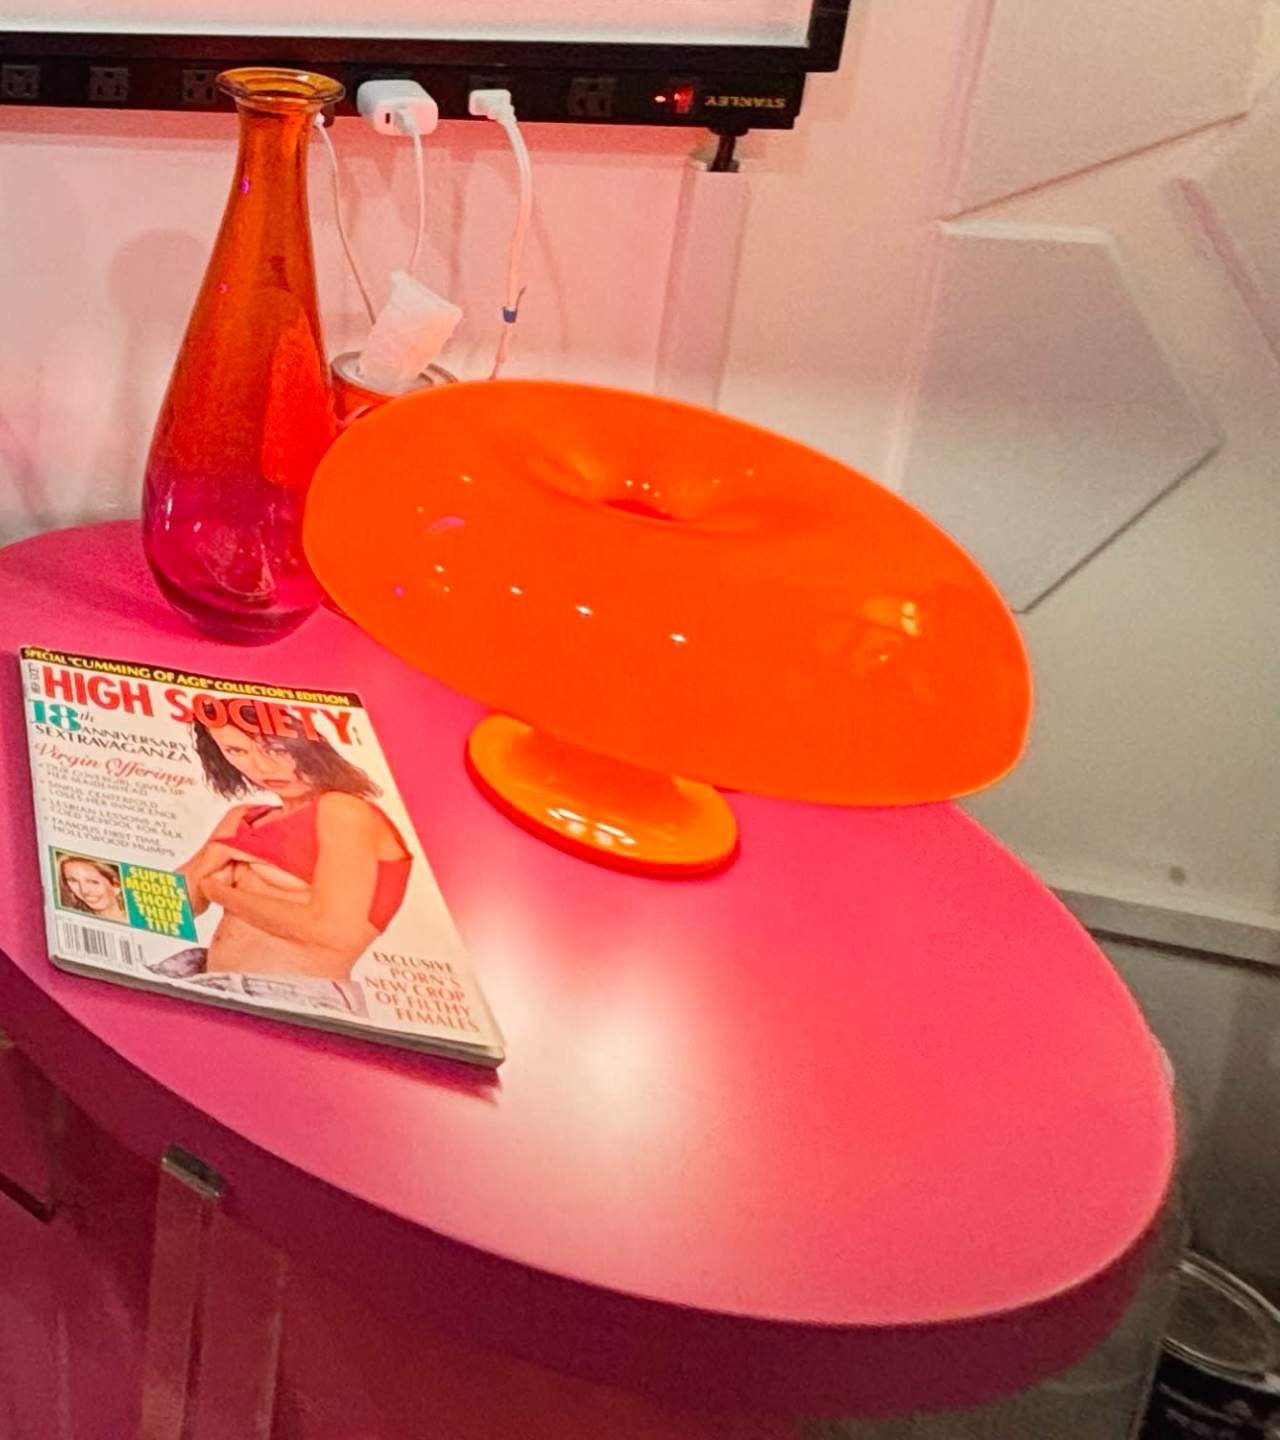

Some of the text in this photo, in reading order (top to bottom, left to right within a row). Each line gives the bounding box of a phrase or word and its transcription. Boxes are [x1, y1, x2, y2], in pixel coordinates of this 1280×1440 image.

[704, 95, 787, 109] STANLEY
[24, 647, 67, 665] SPECIAL
[153, 669, 176, 682] OF
[214, 680, 296, 699] COLLECTOR'S
[296, 691, 350, 706] EDITION
[42, 665, 154, 718] HIGH
[164, 688, 353, 745] SOCIETY
[34, 724, 192, 764] SEXTRAVAGANZA
[81, 726, 188, 752] ANNIVERSARY
[34, 742, 197, 787] Virgin Offerings
[125, 876, 187, 901] MODELS
[128, 866, 177, 887] SUPER
[132, 890, 182, 911] SHOW
[136, 904, 185, 926] THEIR
[143, 917, 181, 937] TITS
[365, 976, 465, 1002] NEW CROP
[375, 990, 471, 1018] OF FILTHY
[395, 1007, 481, 1033] FEMALES
